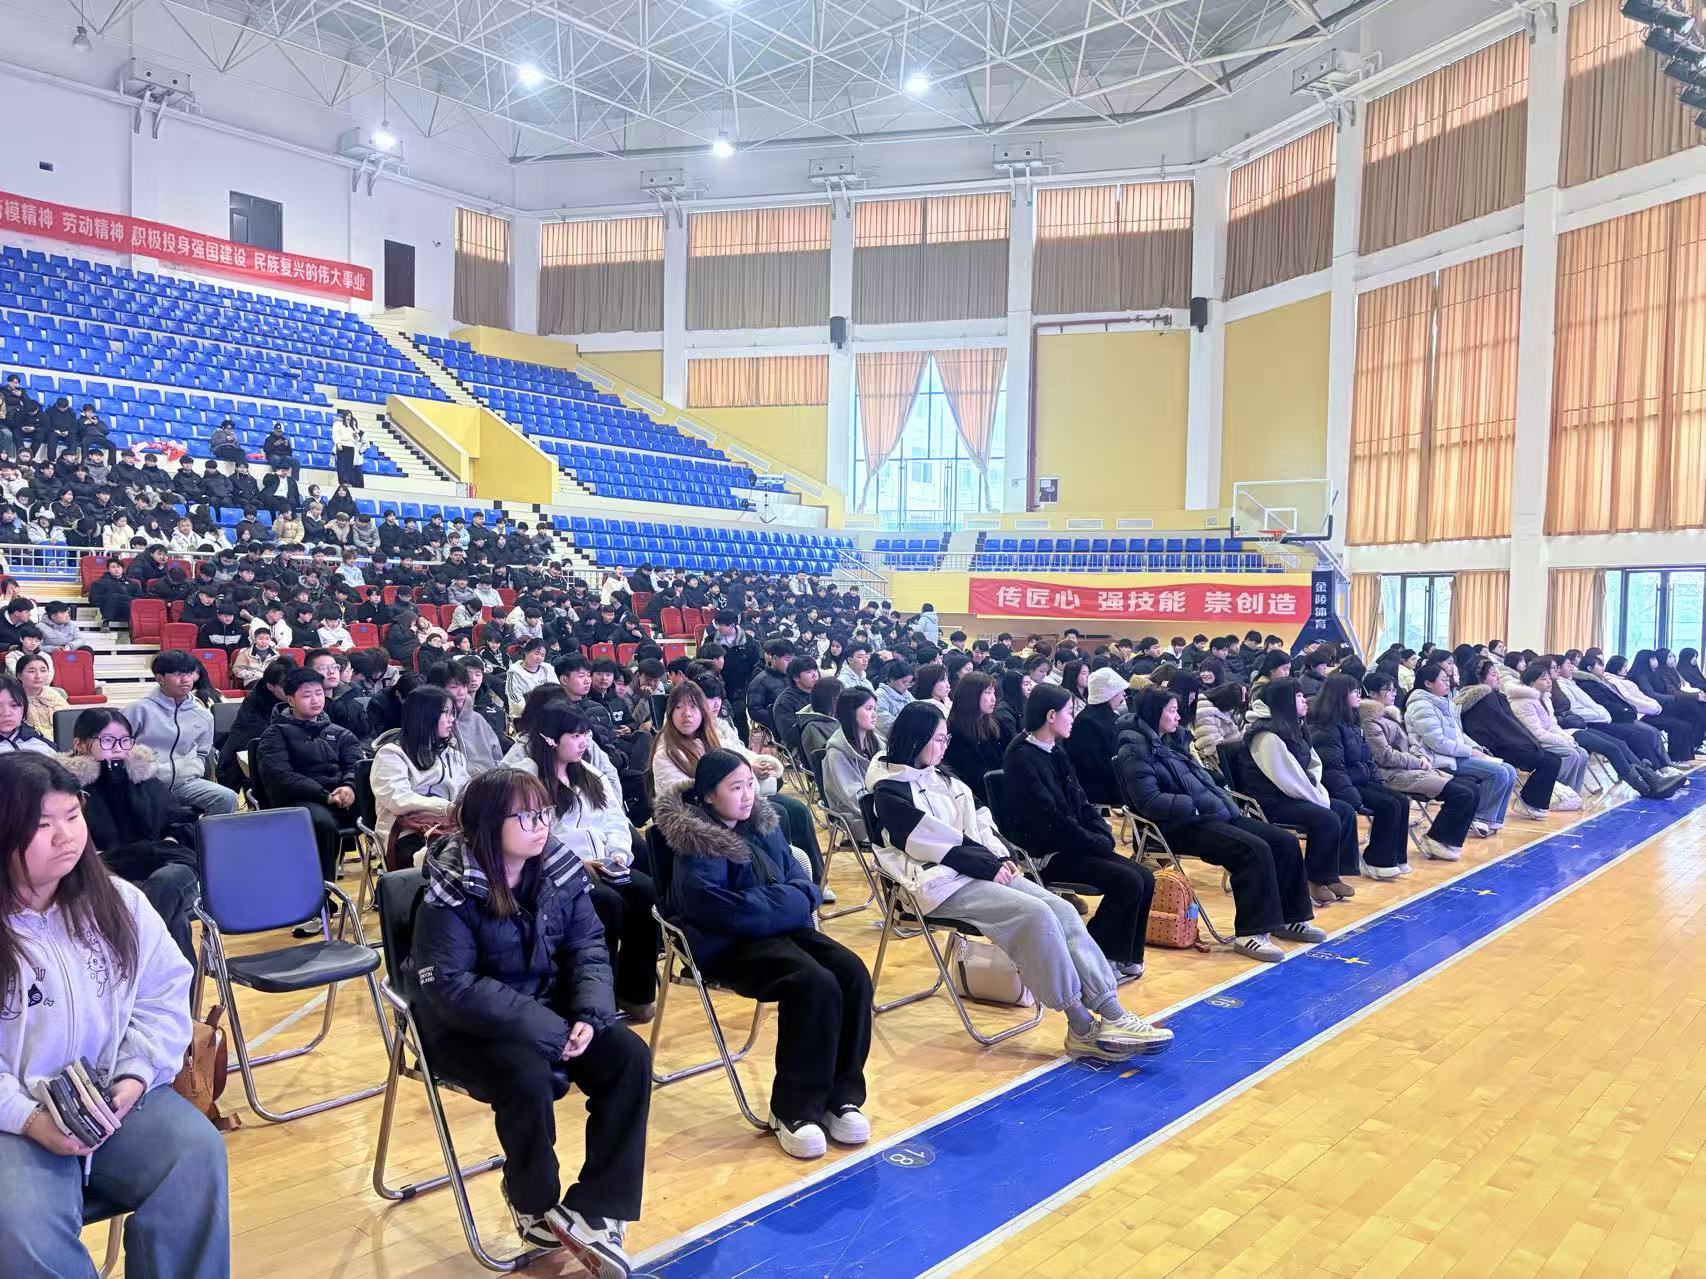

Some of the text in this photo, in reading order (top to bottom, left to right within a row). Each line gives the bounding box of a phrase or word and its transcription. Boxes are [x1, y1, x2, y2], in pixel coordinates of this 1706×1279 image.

[0, 200, 365, 291] 模精神 劳动精神 积极投身强国建设 民族复兴的伟大事业
[997, 586, 1297, 615] 传匠心 强技能 崇创造
[1315, 581, 1327, 630] 金陵体育
[890, 1148, 925, 1165] 18
